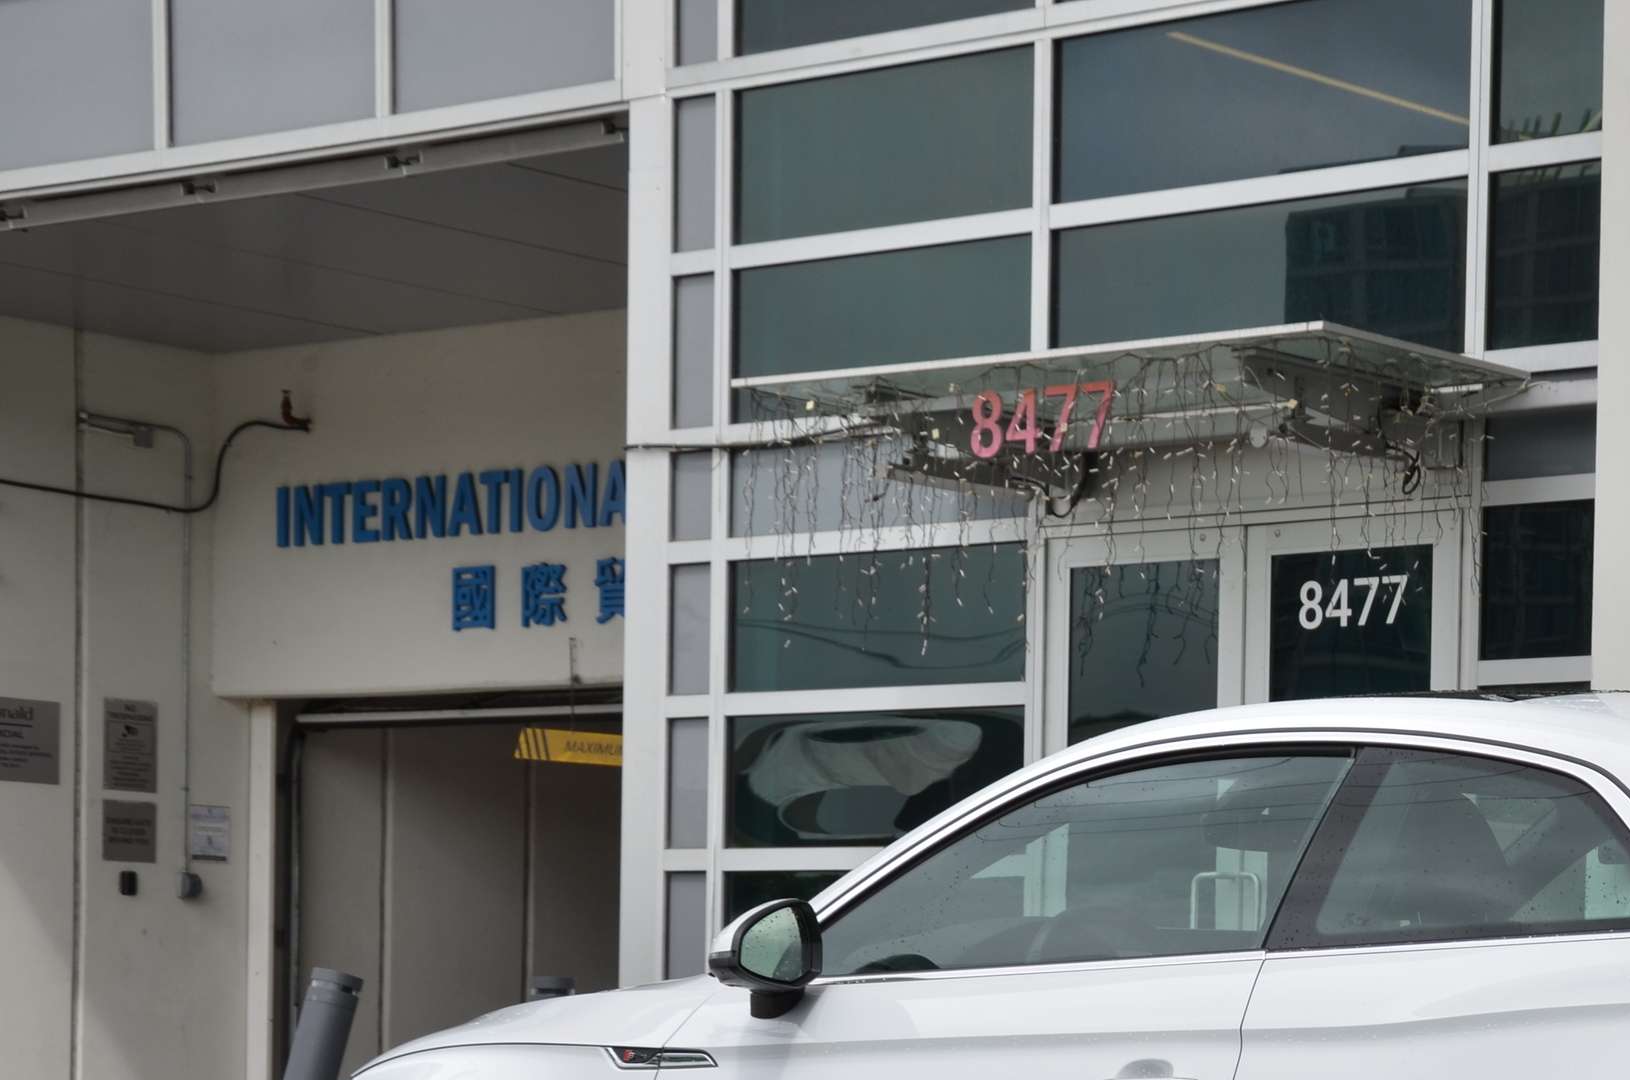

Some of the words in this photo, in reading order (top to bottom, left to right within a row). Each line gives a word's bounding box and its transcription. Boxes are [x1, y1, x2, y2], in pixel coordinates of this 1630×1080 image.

[970, 378, 1114, 458] 8477
[276, 459, 625, 548] INTERNATIONA
[1299, 573, 1408, 630] 8477
